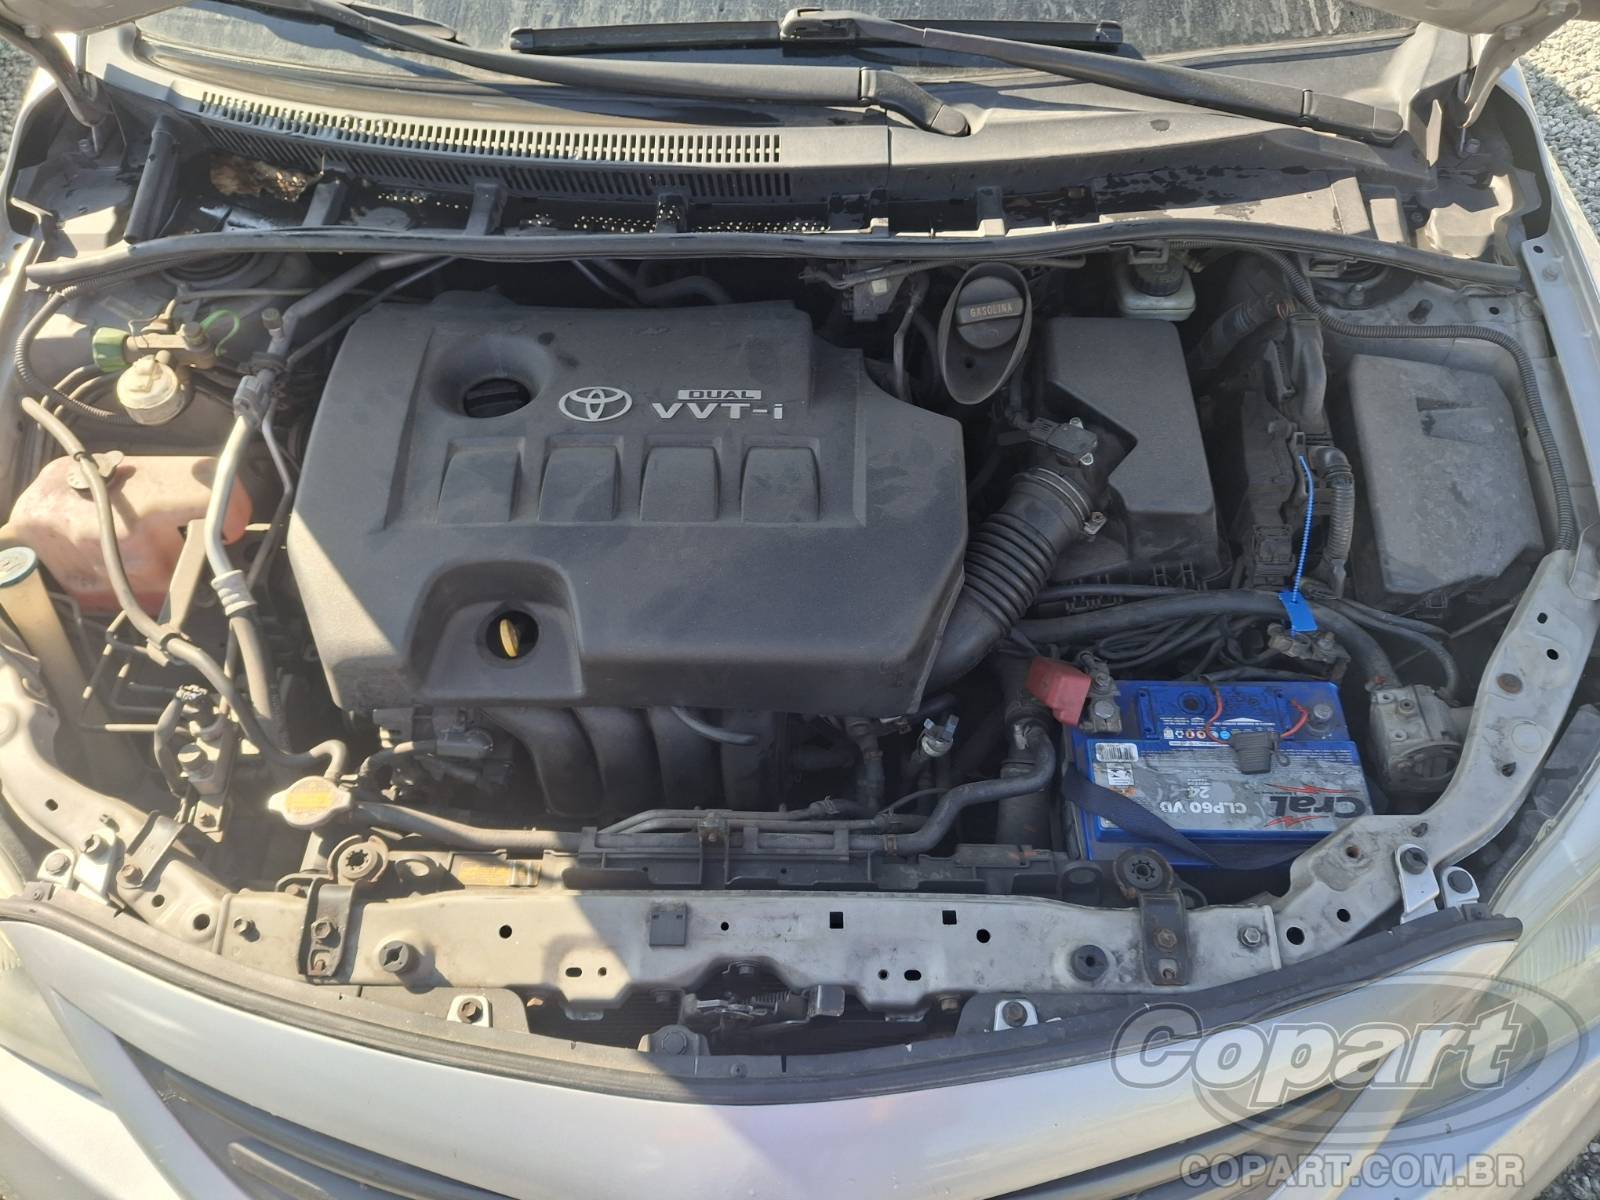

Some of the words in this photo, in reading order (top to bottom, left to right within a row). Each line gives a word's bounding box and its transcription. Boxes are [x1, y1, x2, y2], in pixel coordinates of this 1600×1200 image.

[969, 303, 1014, 318] GASOLINA
[688, 390, 756, 399] DUAL
[651, 402, 784, 420] VVT-i
[1189, 801, 1247, 814] CLP60
